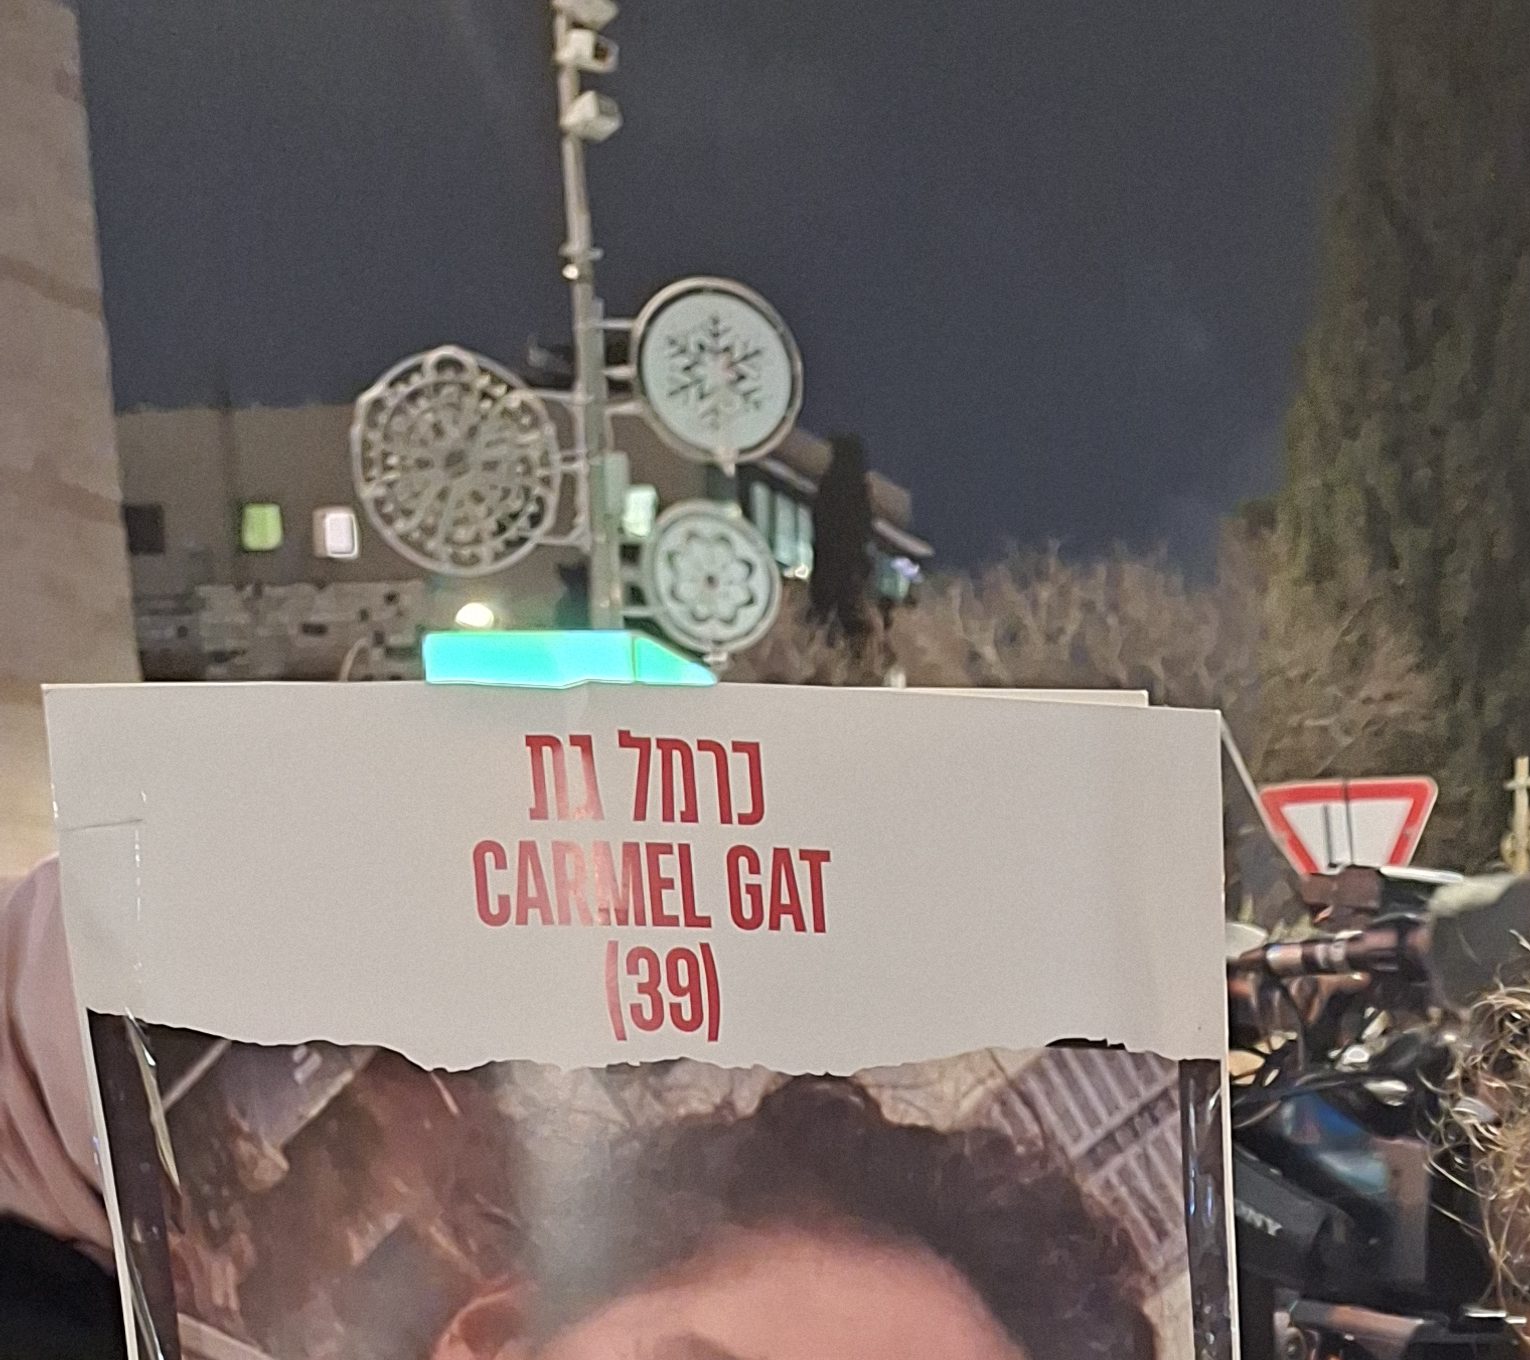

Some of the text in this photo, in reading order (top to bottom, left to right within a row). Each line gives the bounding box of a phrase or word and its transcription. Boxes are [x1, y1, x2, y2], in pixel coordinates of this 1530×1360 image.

[525, 730, 765, 826] כרמל גת
[472, 840, 831, 934] CARMEL GAT
[604, 940, 720, 1042] (39)
